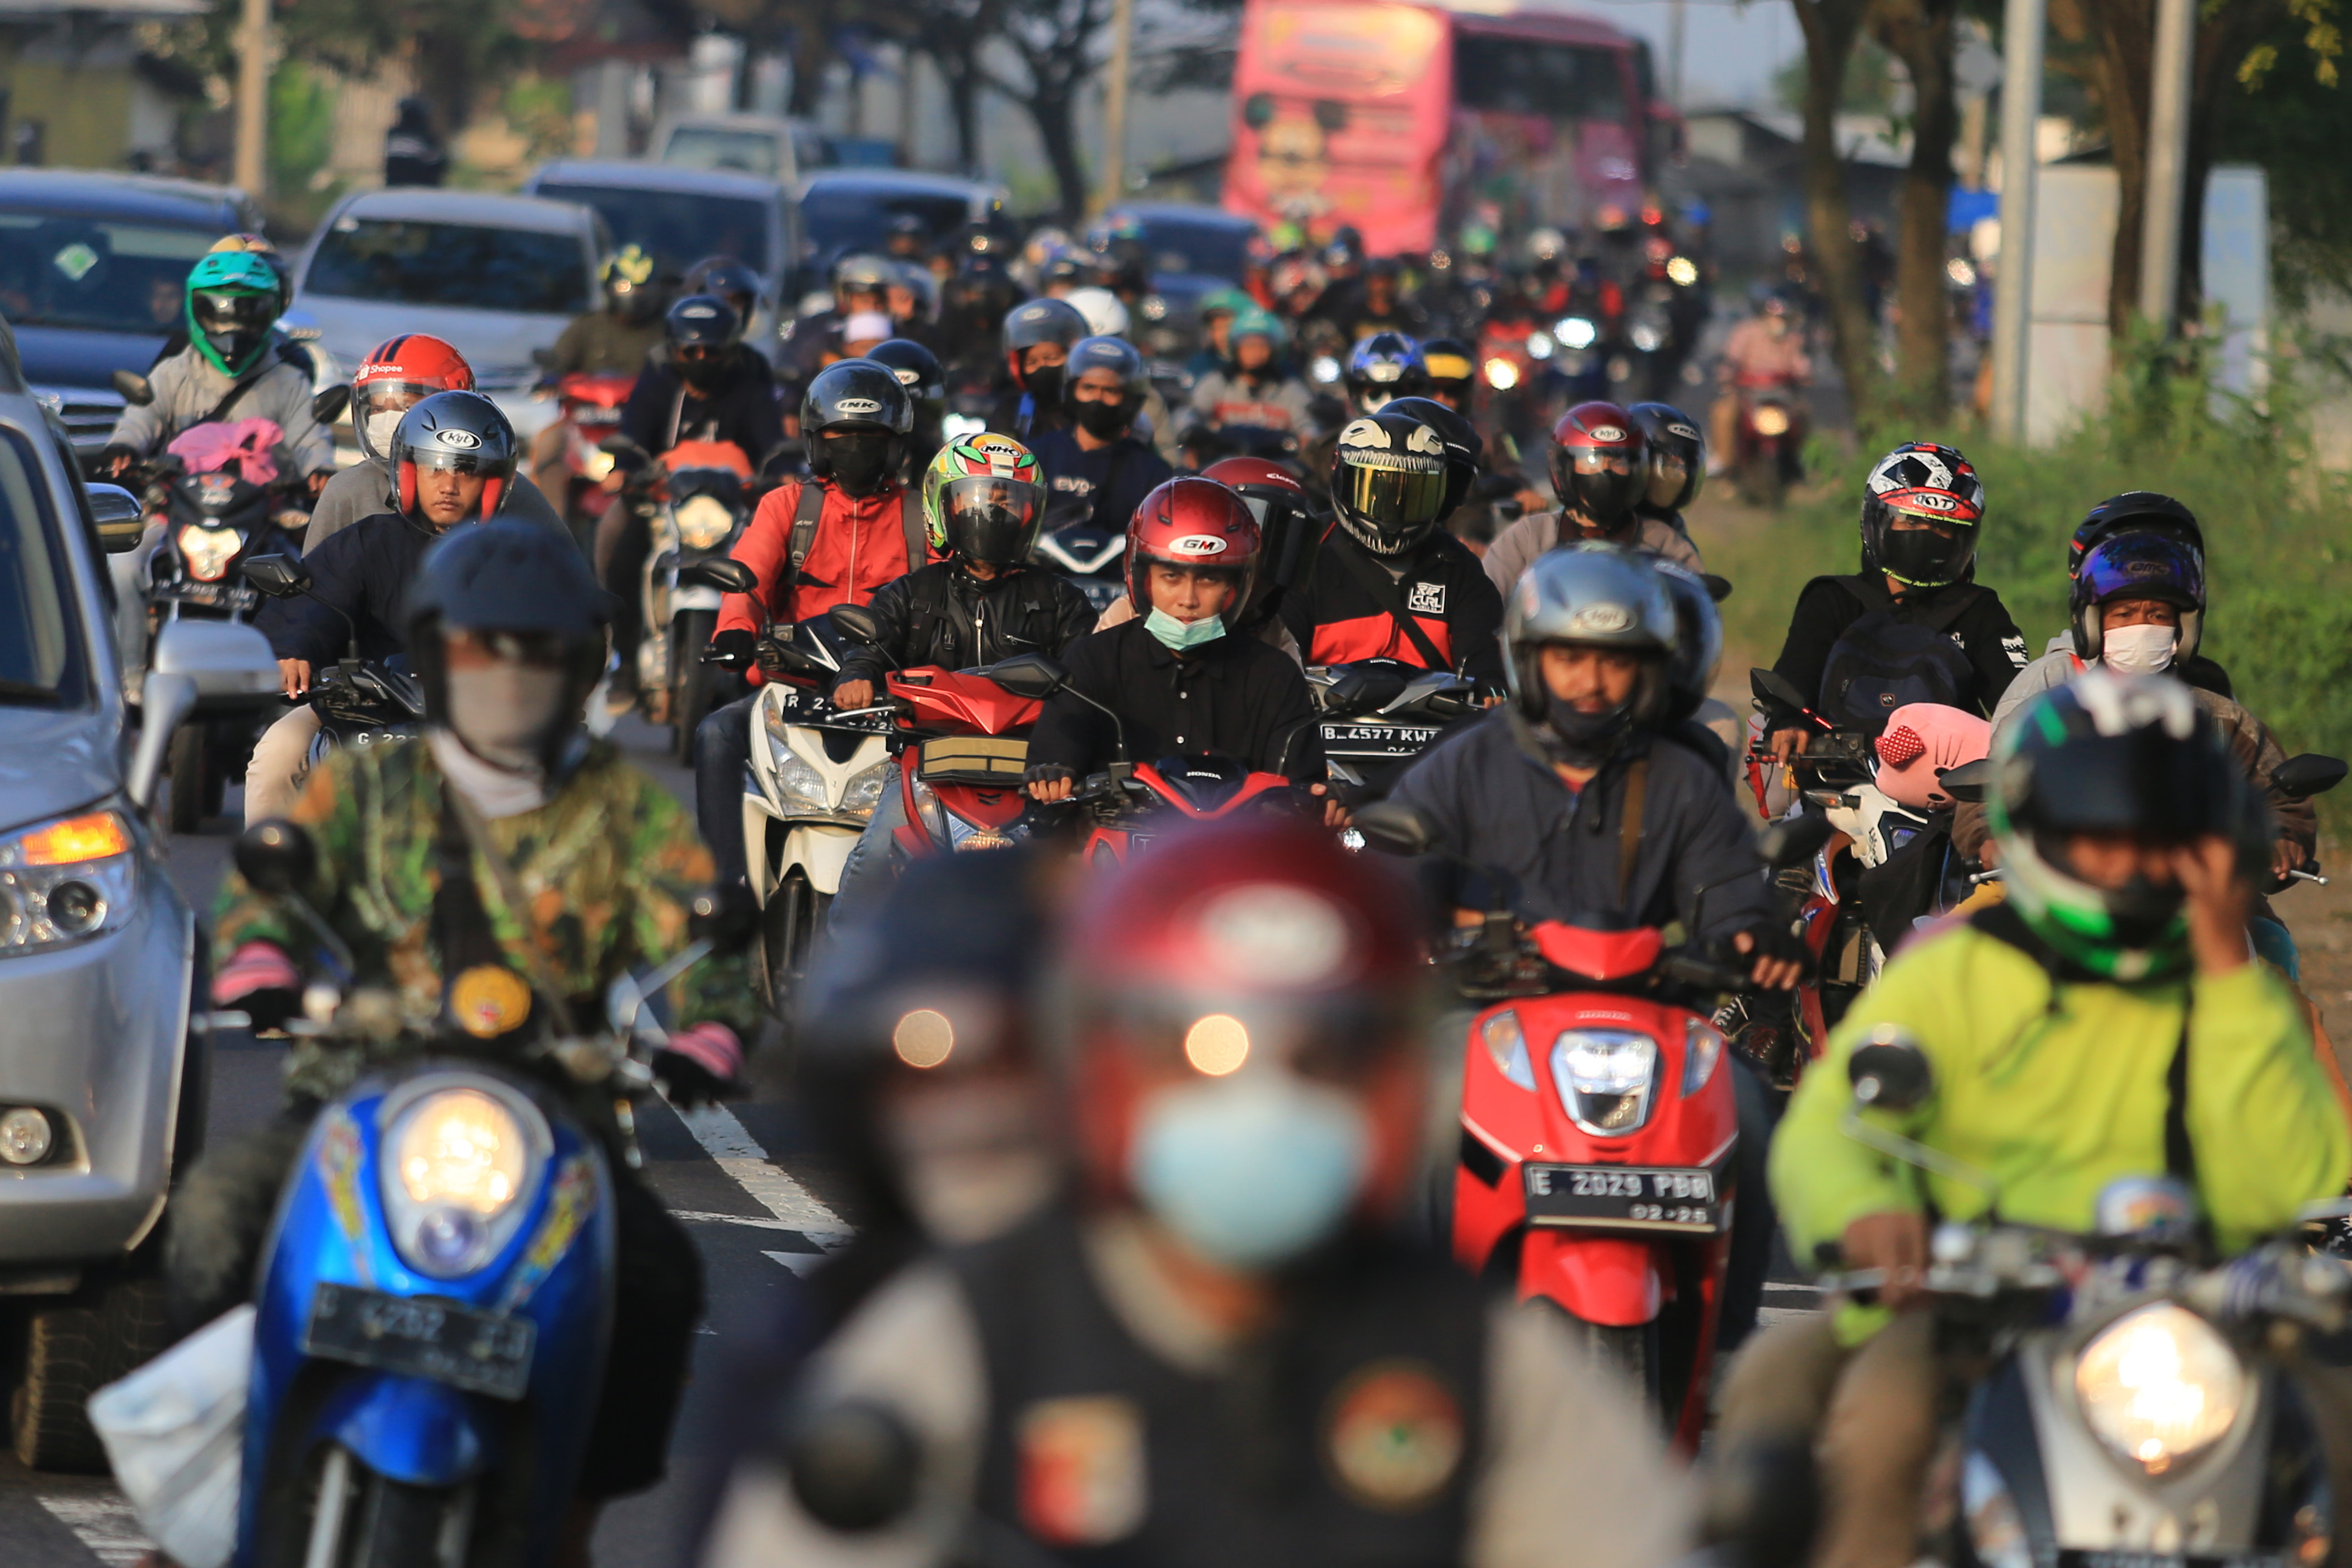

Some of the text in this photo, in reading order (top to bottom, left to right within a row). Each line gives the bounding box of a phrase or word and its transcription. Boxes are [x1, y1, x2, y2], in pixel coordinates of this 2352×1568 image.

[370, 365, 403, 375] Shopee
[1183, 539, 1218, 551] GM
[1416, 584, 1441, 596] RIP
[1412, 595, 1442, 609] CURL
[788, 695, 799, 708] R
[358, 732, 370, 745] G
[1324, 727, 1336, 740] B
[1187, 771, 1222, 780] HONDA
[1535, 1170, 1552, 1195] E
[1571, 1172, 1643, 1197] 2029
